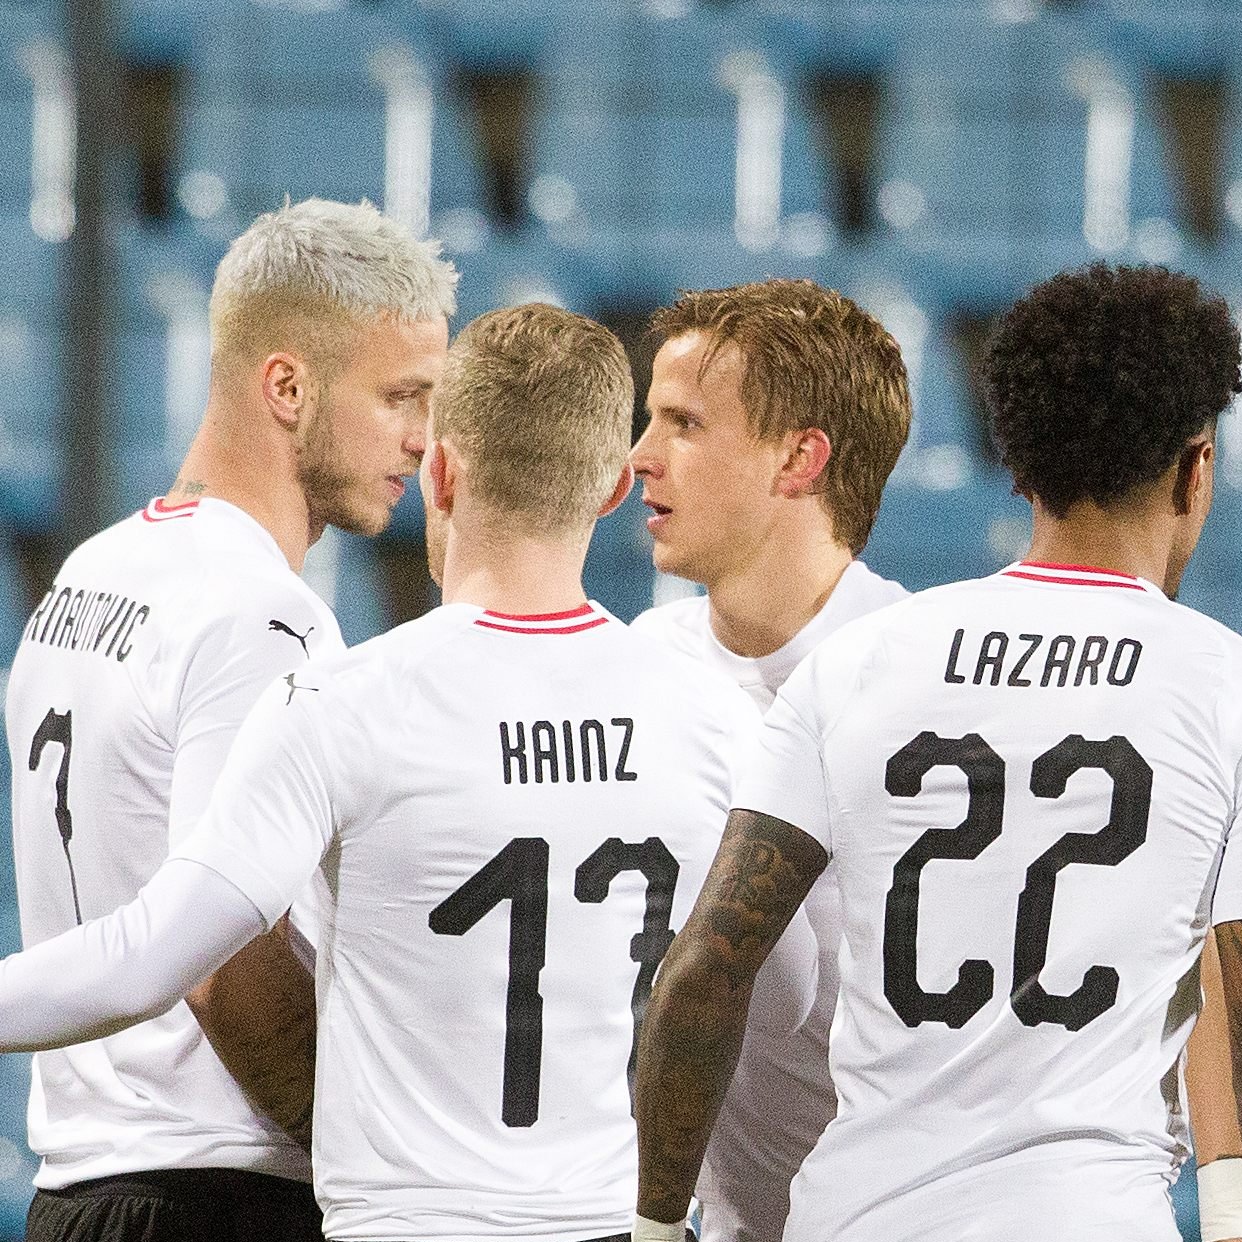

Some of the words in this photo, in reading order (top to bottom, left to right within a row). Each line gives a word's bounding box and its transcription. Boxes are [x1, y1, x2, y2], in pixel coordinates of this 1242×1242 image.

[944, 628, 1143, 687] LAZARO
[499, 718, 638, 785] KAINZ
[883, 731, 1153, 1031] 22
[428, 837, 680, 1128] 17
